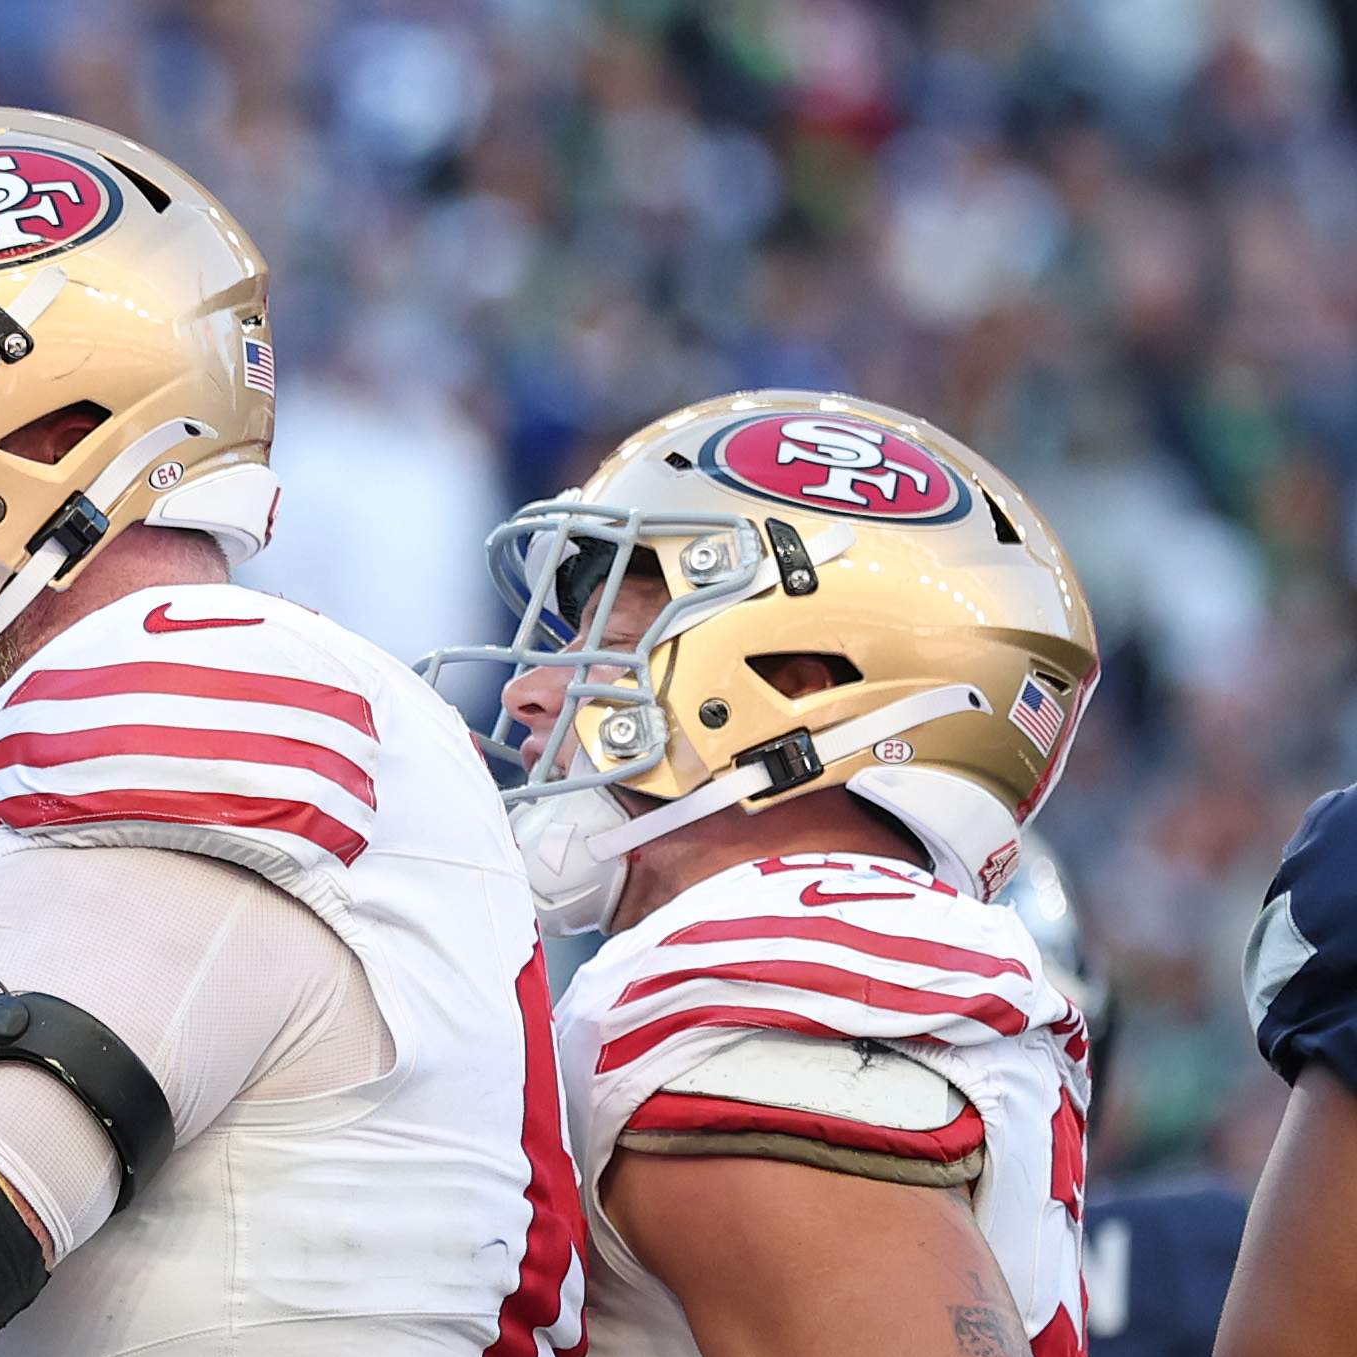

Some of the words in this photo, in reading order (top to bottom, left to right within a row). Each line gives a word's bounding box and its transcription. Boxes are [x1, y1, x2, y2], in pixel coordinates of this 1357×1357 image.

[776, 418, 929, 506] SF
[157, 464, 177, 485] 64
[884, 742, 904, 760] 23
